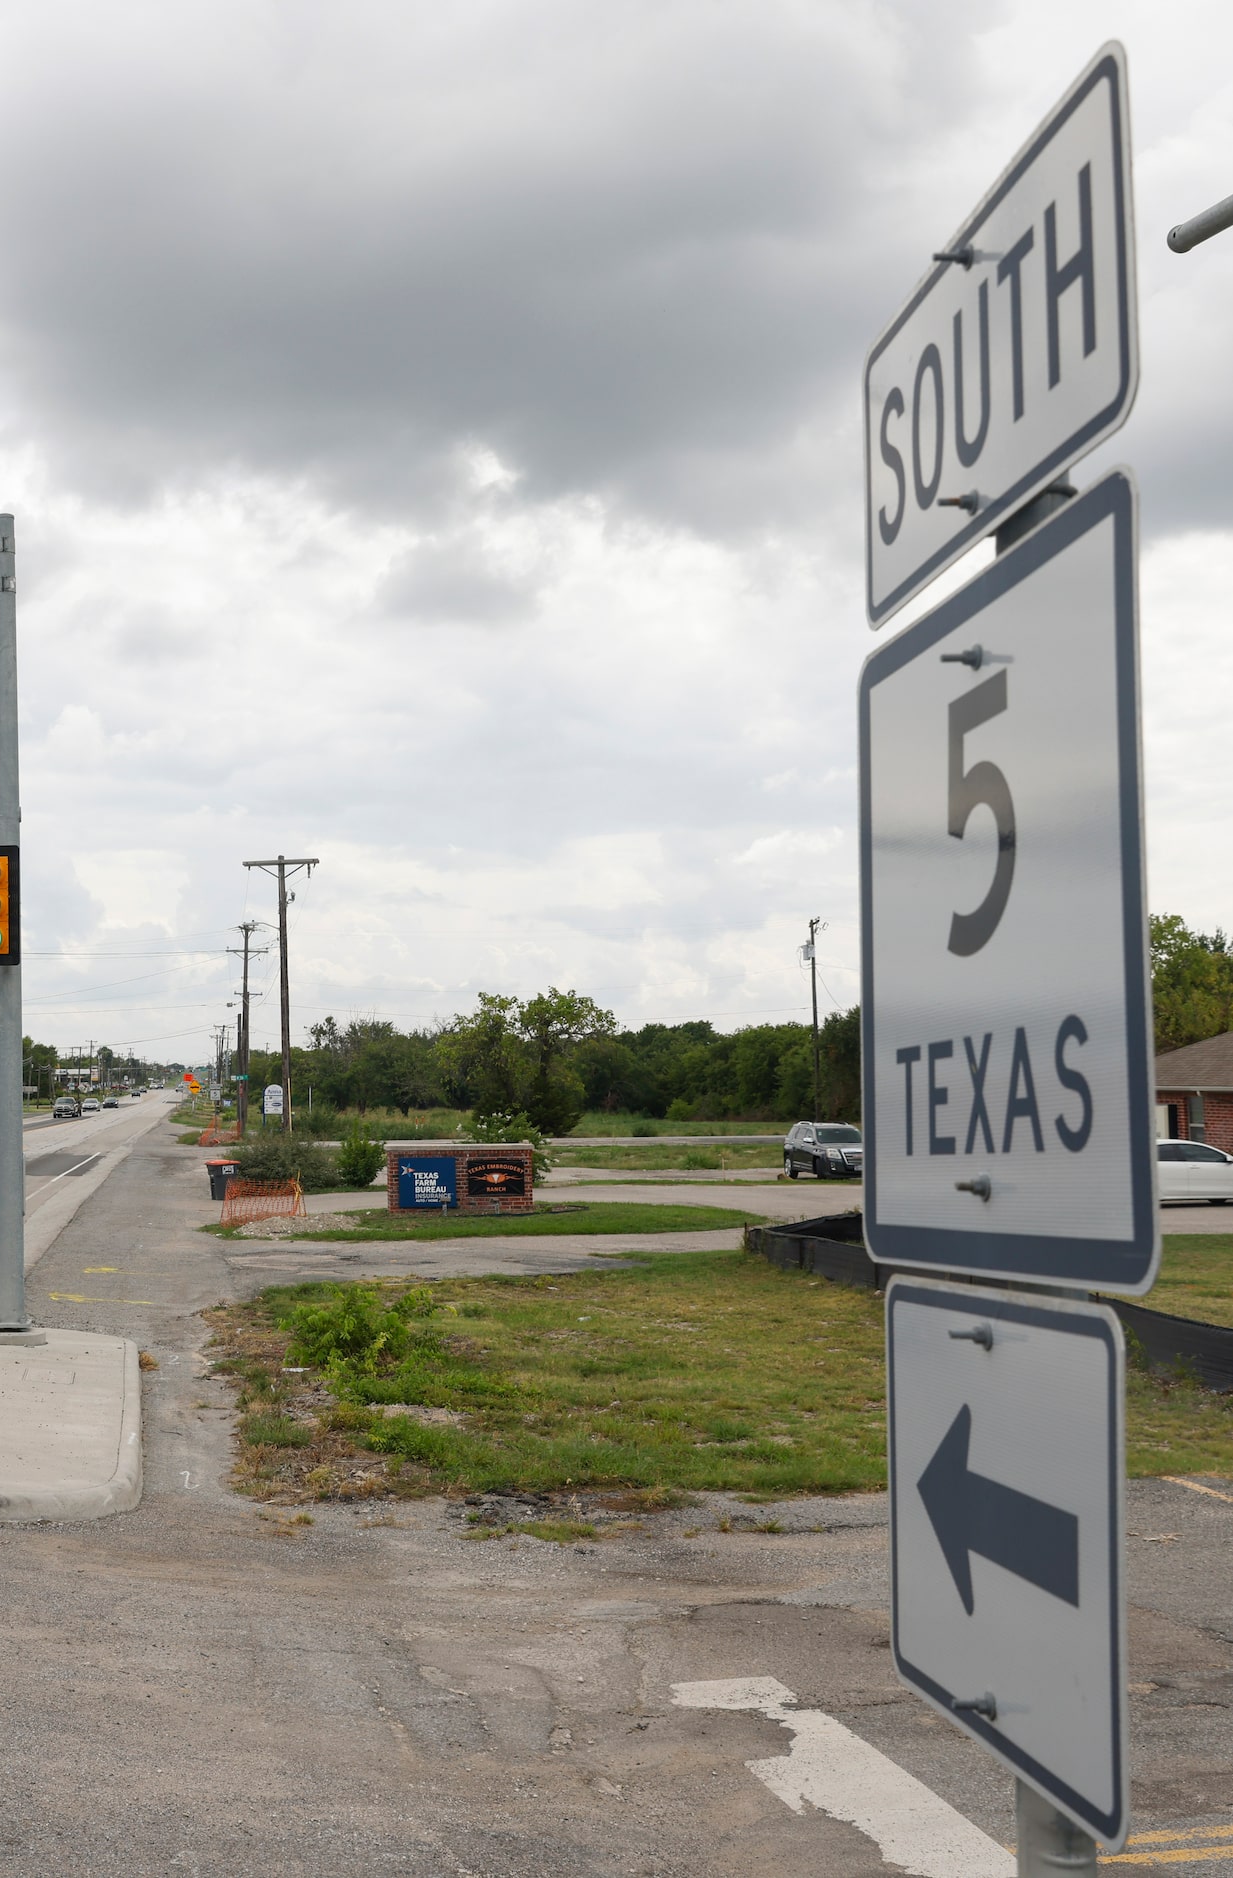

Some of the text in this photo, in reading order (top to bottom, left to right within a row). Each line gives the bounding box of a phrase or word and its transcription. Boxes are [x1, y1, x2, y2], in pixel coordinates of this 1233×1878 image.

[878, 160, 1097, 546] SOUTH
[947, 667, 1017, 958] 5
[468, 1163, 524, 1174] TEXAS EMBROIDERY
[896, 1013, 1093, 1155] TEXAS
